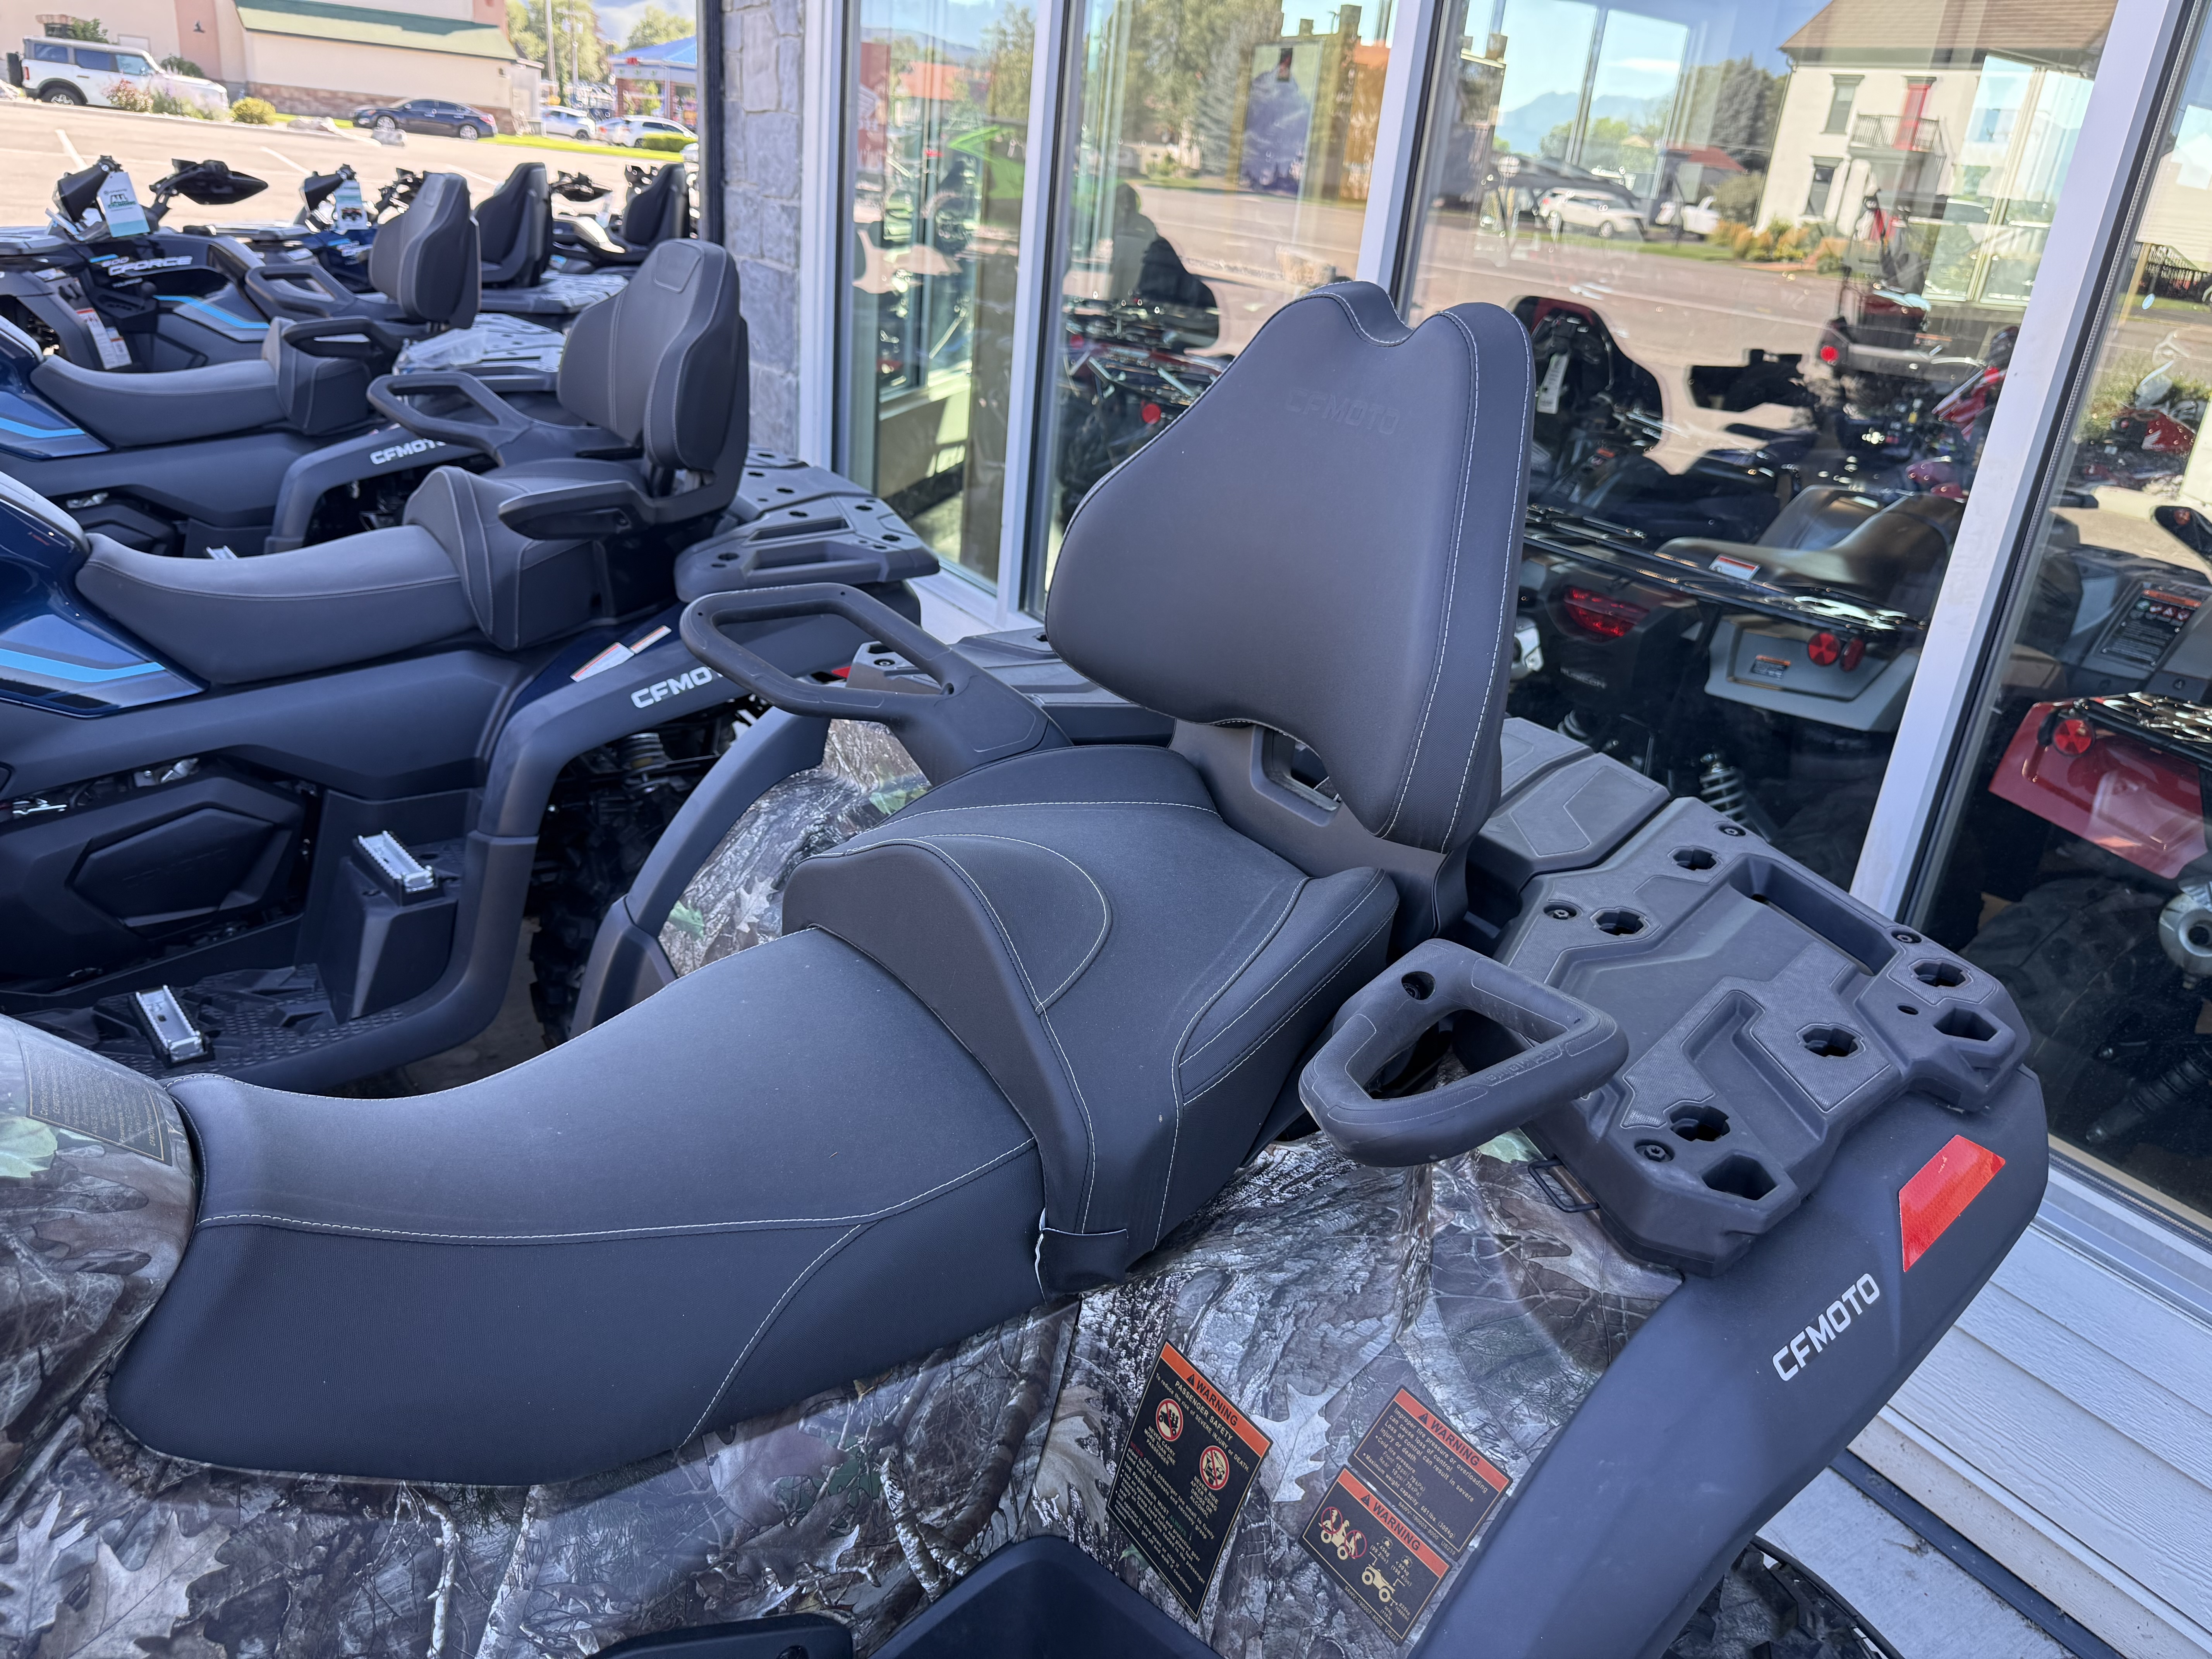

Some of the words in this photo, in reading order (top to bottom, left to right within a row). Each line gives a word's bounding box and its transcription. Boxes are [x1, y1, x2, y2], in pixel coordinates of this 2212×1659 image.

[108, 256, 193, 276] CFORCE
[1286, 388, 1400, 434] CFMOTO
[630, 666, 723, 708] CFMO
[1772, 1273, 1880, 1381] CFMOTO
[1155, 1372, 1161, 1381] To
[1161, 1378, 1174, 1395] reduce
[1181, 1399, 1190, 1411] risk
[1189, 1408, 1195, 1417] of
[1195, 1413, 1212, 1434] SEVERE
[1212, 1431, 1228, 1450] INJURY
[1228, 1448, 1233, 1456] or
[1233, 1453, 1250, 1473] DEATH.
[1175, 1379, 1209, 1418] PASSENGER
[1209, 1415, 1233, 1443] SAFETY
[1195, 1380, 1238, 1427] WARNING
[1144, 1427, 1156, 1443] MORE
[1156, 1441, 1166, 1456] THAN
[1166, 1453, 1176, 1465] ONE
[1146, 1437, 1170, 1467] PASSENGER
[1148, 1425, 1161, 1442] NEVER
[1161, 1439, 1175, 1458] CARRY
[1377, 1436, 1389, 1448] Cold
[1387, 1446, 1397, 1456] tire
[1379, 1426, 1396, 1443] injury
[1395, 1441, 1402, 1449] or
[1401, 1446, 1419, 1463] death.
[1389, 1415, 1399, 1425] can
[1398, 1423, 1415, 1439] cause
[1414, 1436, 1427, 1449] loss
[1426, 1446, 1434, 1455] of
[1393, 1407, 1417, 1431] Improper
[1416, 1427, 1427, 1438] tire
[1425, 1437, 1449, 1460] pressure
[1449, 1457, 1456, 1465] or
[1455, 1462, 1489, 1494] overloading
[1429, 1420, 1481, 1467] WARNING
[1126, 1452, 1136, 1466] hand
[1365, 1454, 1386, 1475] Maximum
[1384, 1472, 1400, 1489] weight
[1384, 1420, 1398, 1434] Loss
[1397, 1431, 1405, 1440] of
[1403, 1437, 1423, 1456] control
[1422, 1455, 1433, 1466] can
[1432, 1463, 1449, 1480] result
[1449, 1477, 1456, 1486] in
[1455, 1484, 1474, 1503] severe
[1123, 1460, 1132, 1473] THE
[1132, 1470, 1157, 1502] PASSENGER
[1157, 1499, 1169, 1516] MUST
[1169, 1514, 1187, 1537] ALWAYS
[1128, 1446, 1138, 1461] plant
[1138, 1457, 1146, 1469] feet
[1146, 1467, 1152, 1476] on
[1152, 1473, 1170, 1496] footrests
[1170, 1494, 1178, 1506] and
[1177, 1503, 1195, 1526] securely
[1194, 1523, 1207, 1541] grasp
[1143, 1456, 1154, 1471] carry
[1157, 1472, 1178, 1498] passenger
[1185, 1503, 1197, 1519] small
[1197, 1516, 1202, 1525] to
[1202, 1522, 1215, 1540] firmly
[1189, 1494, 1209, 1519] ALCOHOL
[1190, 1479, 1204, 1497] AFTER
[1204, 1494, 1218, 1512] USING
[1190, 1487, 1206, 1506] DRUGS
[1205, 1504, 1212, 1515] OR
[1193, 1475, 1208, 1493] NEVER
[1207, 1491, 1219, 1505] RIDE
[1122, 1475, 1137, 1496] securely
[1137, 1494, 1148, 1509] grasp
[1148, 1505, 1157, 1519] hand
[1157, 1516, 1168, 1532] holds
[1175, 1538, 1185, 1553] plant
[1185, 1550, 1193, 1562] feet
[1136, 1484, 1153, 1507] approved
[1152, 1504, 1165, 1521] helmet
[1172, 1527, 1191, 1553] protective
[1191, 1550, 1200, 1563] gear
[1371, 1502, 1422, 1552] WARNING
[1131, 1494, 1136, 1502] on
[1136, 1499, 1152, 1521] footrests
[1152, 1518, 1163, 1533] while
[1162, 1531, 1175, 1548] seated
[1185, 1559, 1205, 1586] passenger
[1440, 1540, 1456, 1556] US239
[1384, 1626, 1399, 1643] US231
